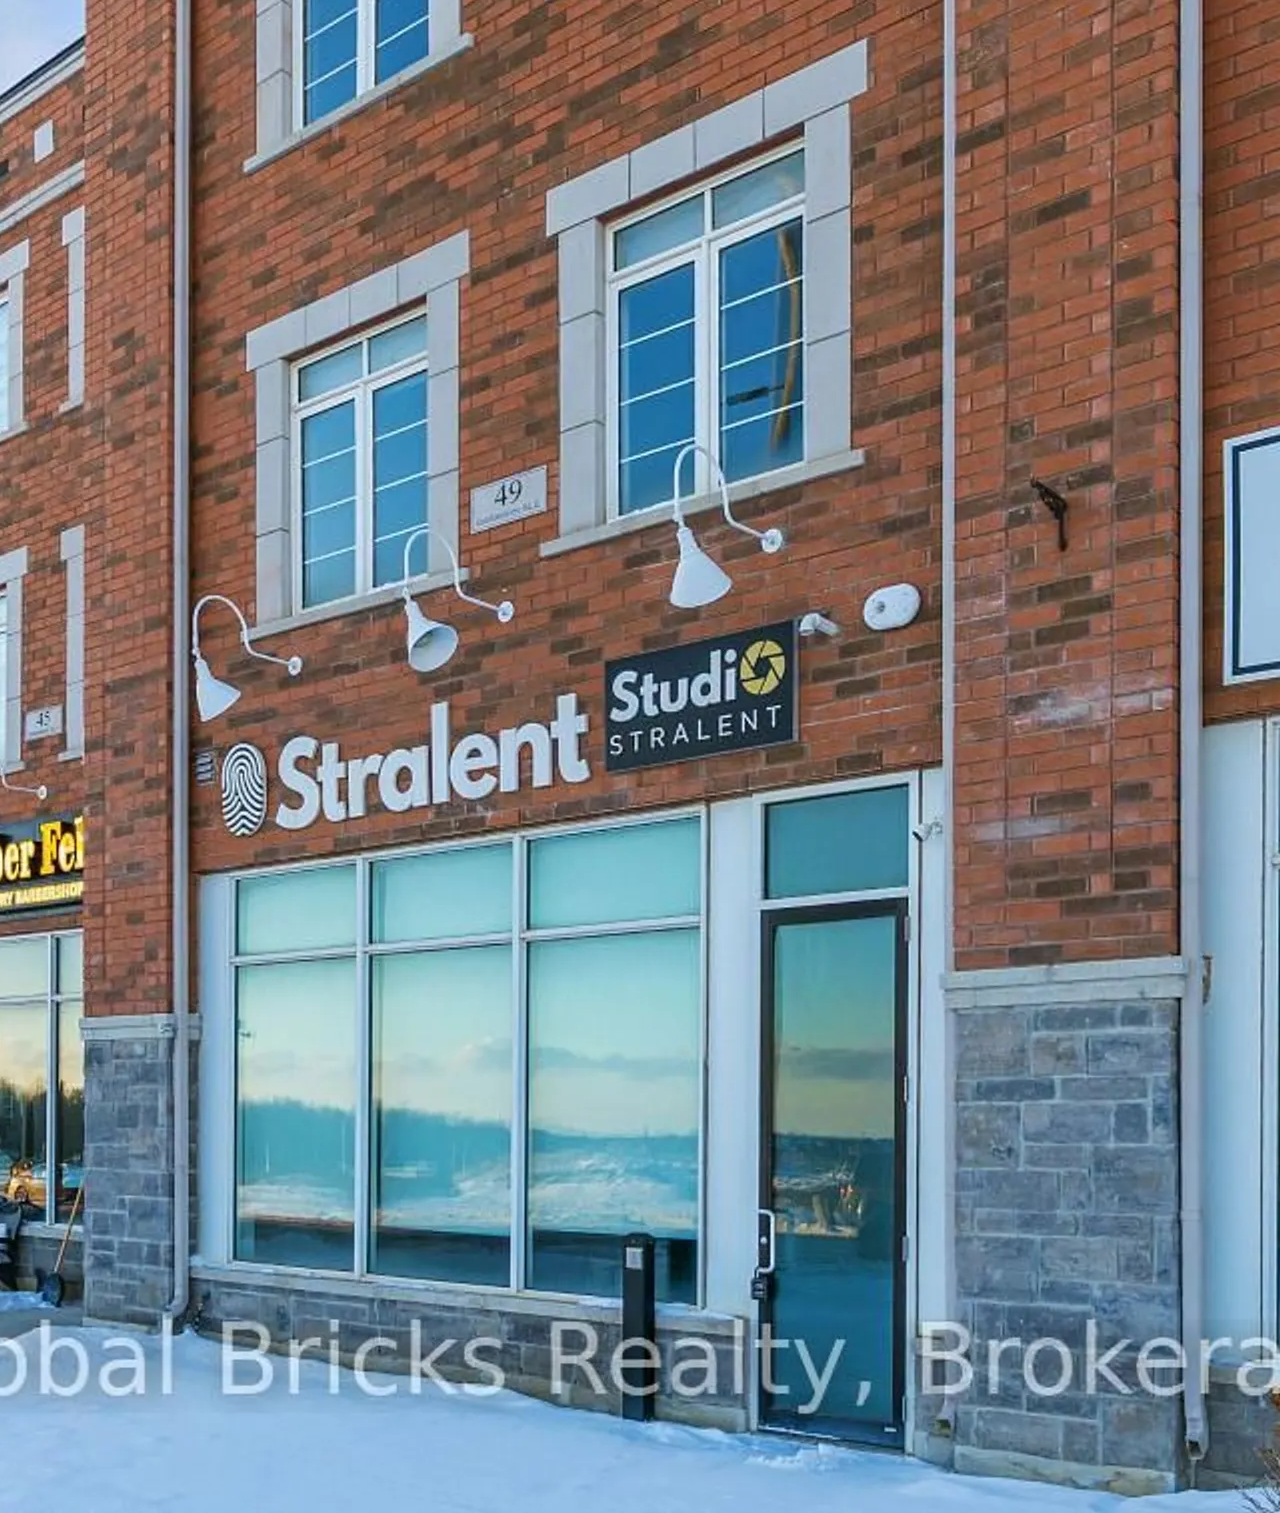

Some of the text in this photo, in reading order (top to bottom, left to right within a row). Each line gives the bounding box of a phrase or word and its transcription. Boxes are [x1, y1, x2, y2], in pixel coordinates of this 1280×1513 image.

[494, 479, 523, 506] 49
[35, 710, 51, 727] 45
[609, 704, 782, 755] STRALENT
[275, 692, 591, 831] Stralent
